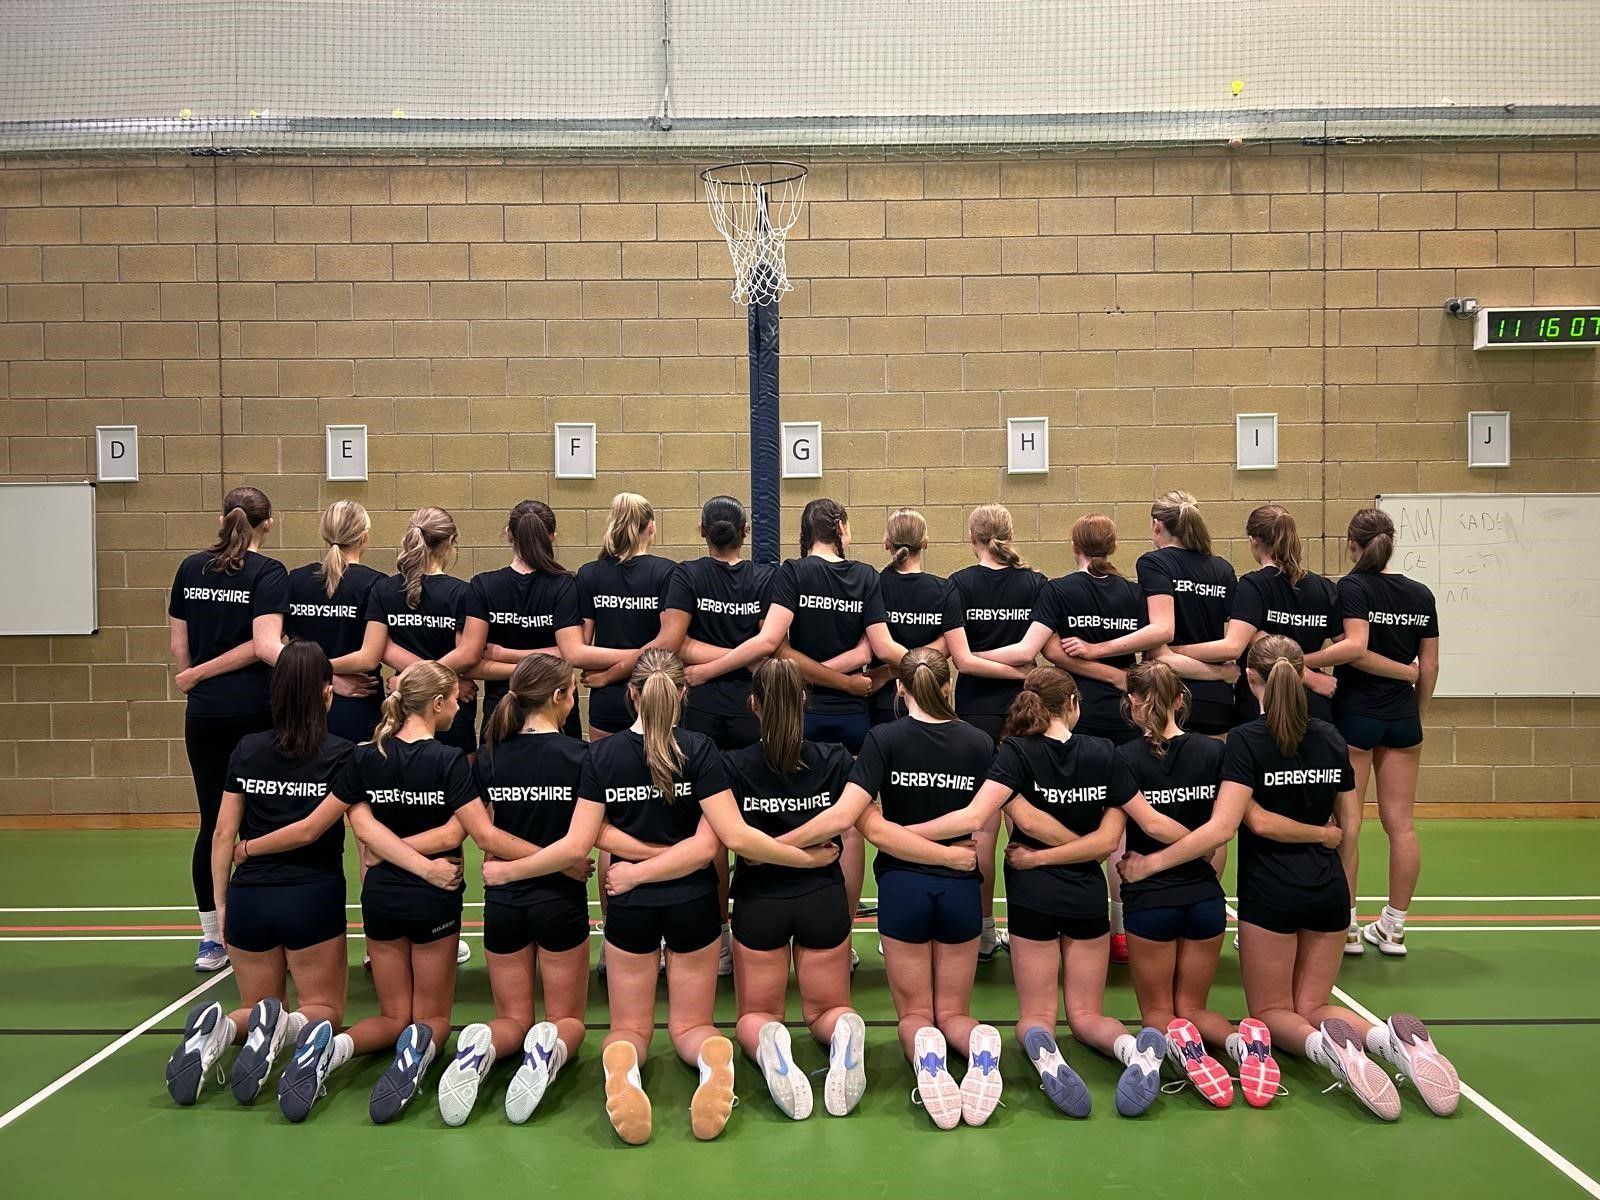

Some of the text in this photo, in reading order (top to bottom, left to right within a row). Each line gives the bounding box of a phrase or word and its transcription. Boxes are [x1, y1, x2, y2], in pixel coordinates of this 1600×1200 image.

[1499, 317, 1600, 337] 11 16 07
[1021, 432, 1035, 451] H
[1483, 426, 1492, 445] J
[110, 440, 125, 459] D
[342, 439, 353, 459] E
[571, 438, 581, 457] F
[792, 438, 810, 461] G
[184, 588, 250, 603] DERBYSHIRE
[290, 604, 357, 617] DERBYSHIRE
[489, 612, 553, 628] DERBSHIRE
[1068, 616, 1137, 630] DERBSHIRE
[891, 772, 975, 791] DERBYSHIRE
[1265, 769, 1341, 786] DERBYSHIRE
[488, 787, 572, 801] DERBYSHIRE
[606, 782, 691, 802] DERBYSRE
[1144, 785, 1216, 804] ERBYSHIRE
[744, 792, 831, 813] DERBYSHIRE
